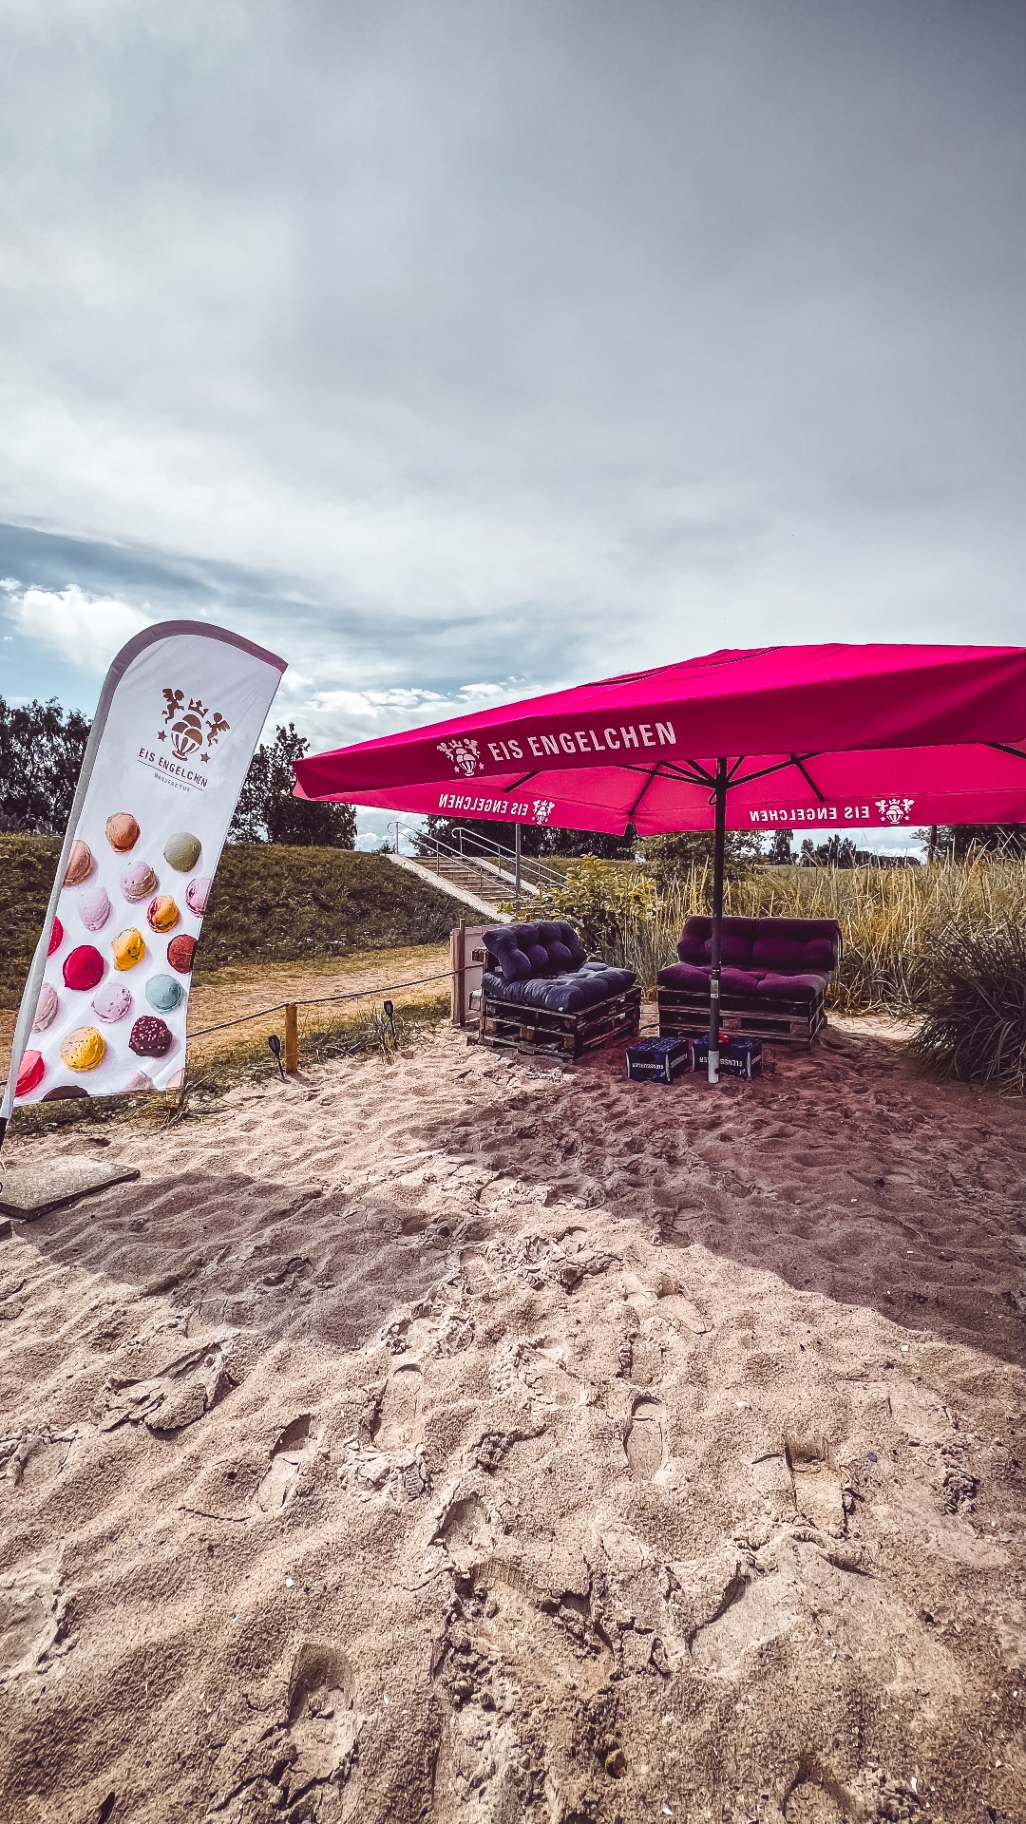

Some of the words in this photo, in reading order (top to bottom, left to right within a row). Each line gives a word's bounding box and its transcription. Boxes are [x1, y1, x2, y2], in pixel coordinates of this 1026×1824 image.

[487, 739, 524, 762] EIS
[527, 721, 677, 757] ENGELCHEN
[138, 747, 156, 762] EIS
[158, 757, 208, 787] ENGELCHEN
